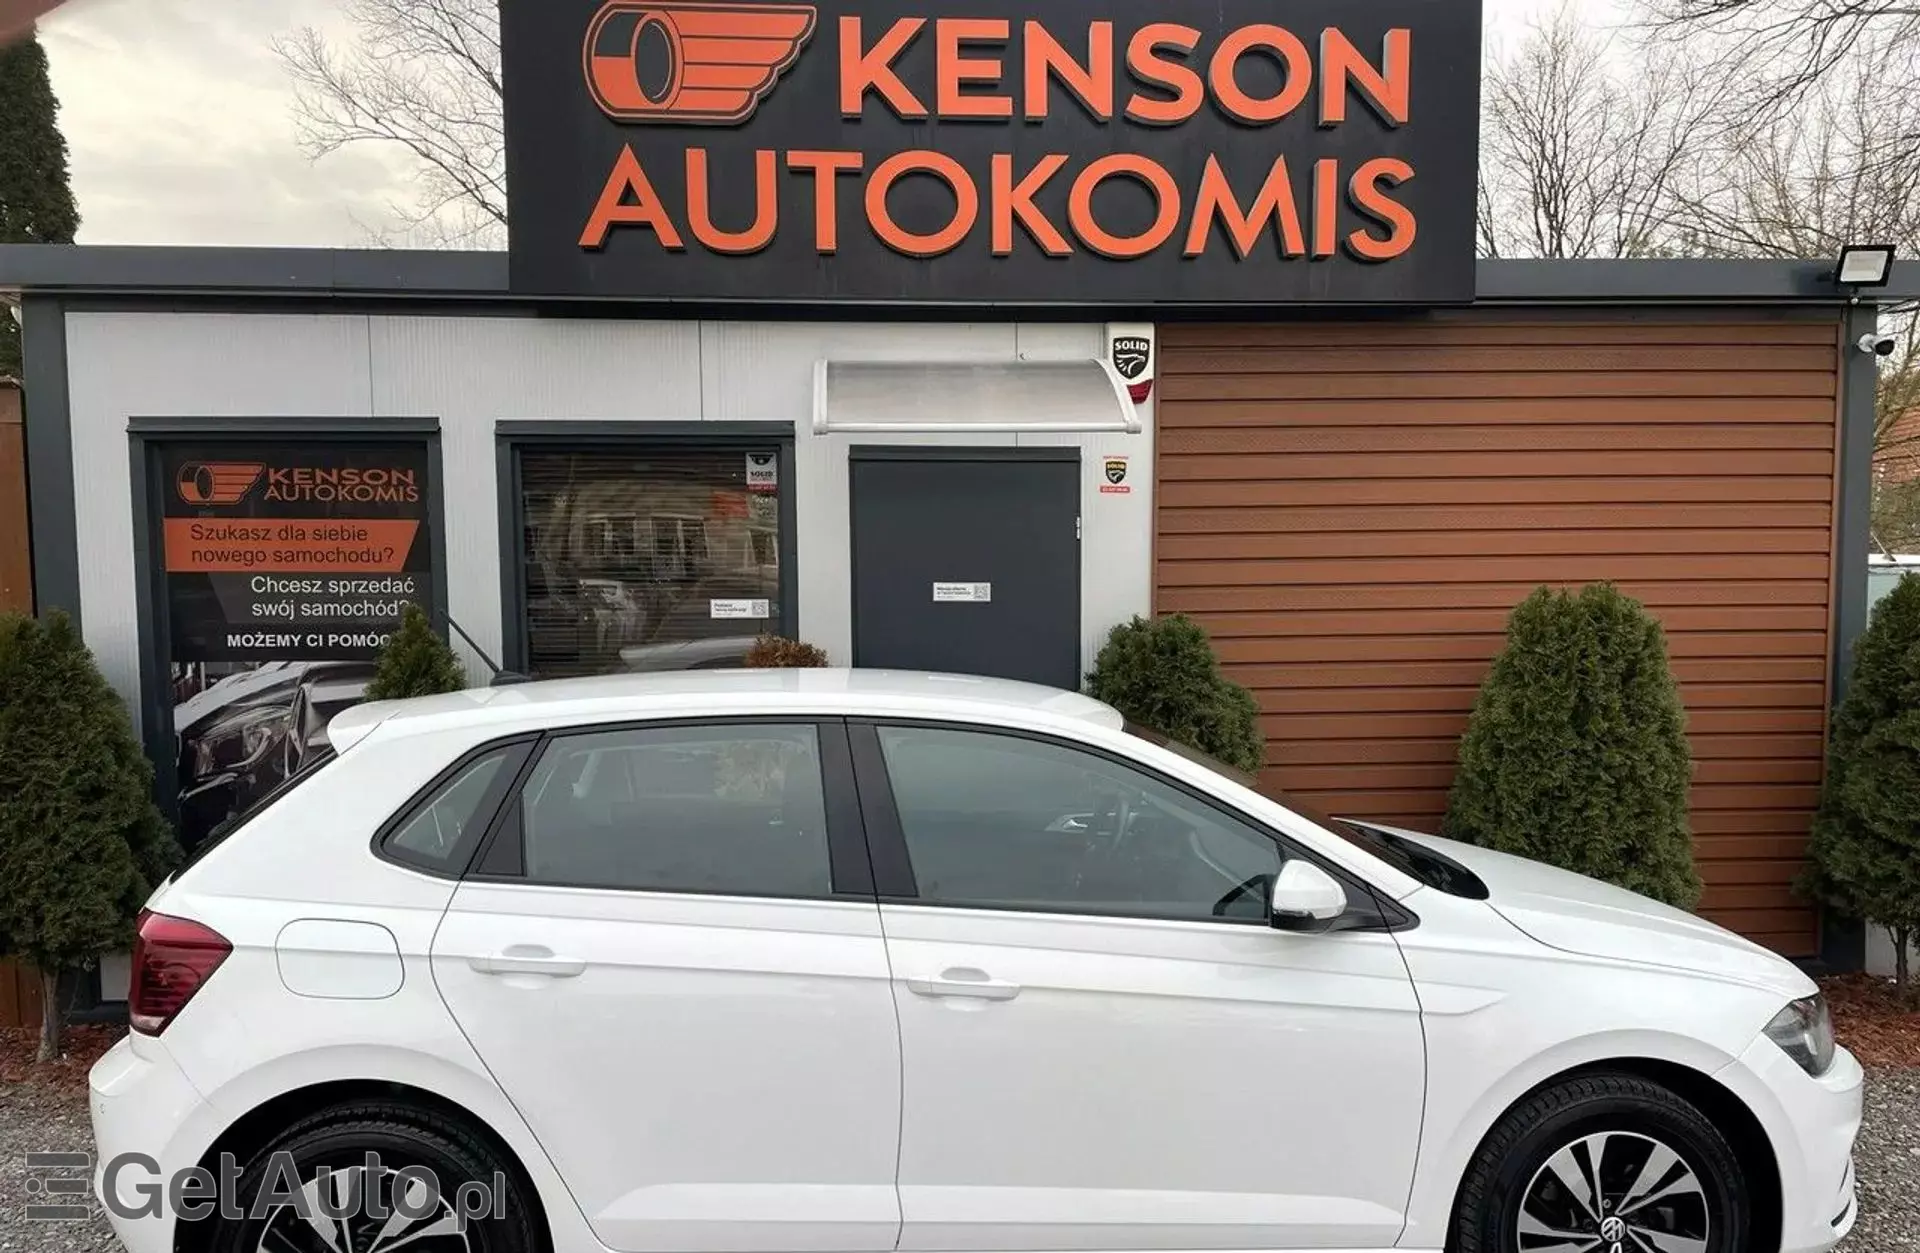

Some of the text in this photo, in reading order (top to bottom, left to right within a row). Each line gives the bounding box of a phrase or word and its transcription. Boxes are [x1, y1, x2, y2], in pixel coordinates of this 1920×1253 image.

[839, 16, 1412, 128] KENSON
[578, 142, 1417, 262] AUTOKOMIS
[1114, 340, 1148, 352] SOLID
[267, 467, 415, 486] KENSON
[263, 484, 420, 502] AUTOKOMIS
[190, 523, 368, 542] Szukasz dla siebie
[191, 546, 394, 567] nowego samochodu?
[251, 576, 415, 597] Chcesz sprzedać
[252, 600, 409, 620] swój samochód
[227, 631, 301, 648] MOŻEMY
[306, 634, 323, 648] CI
